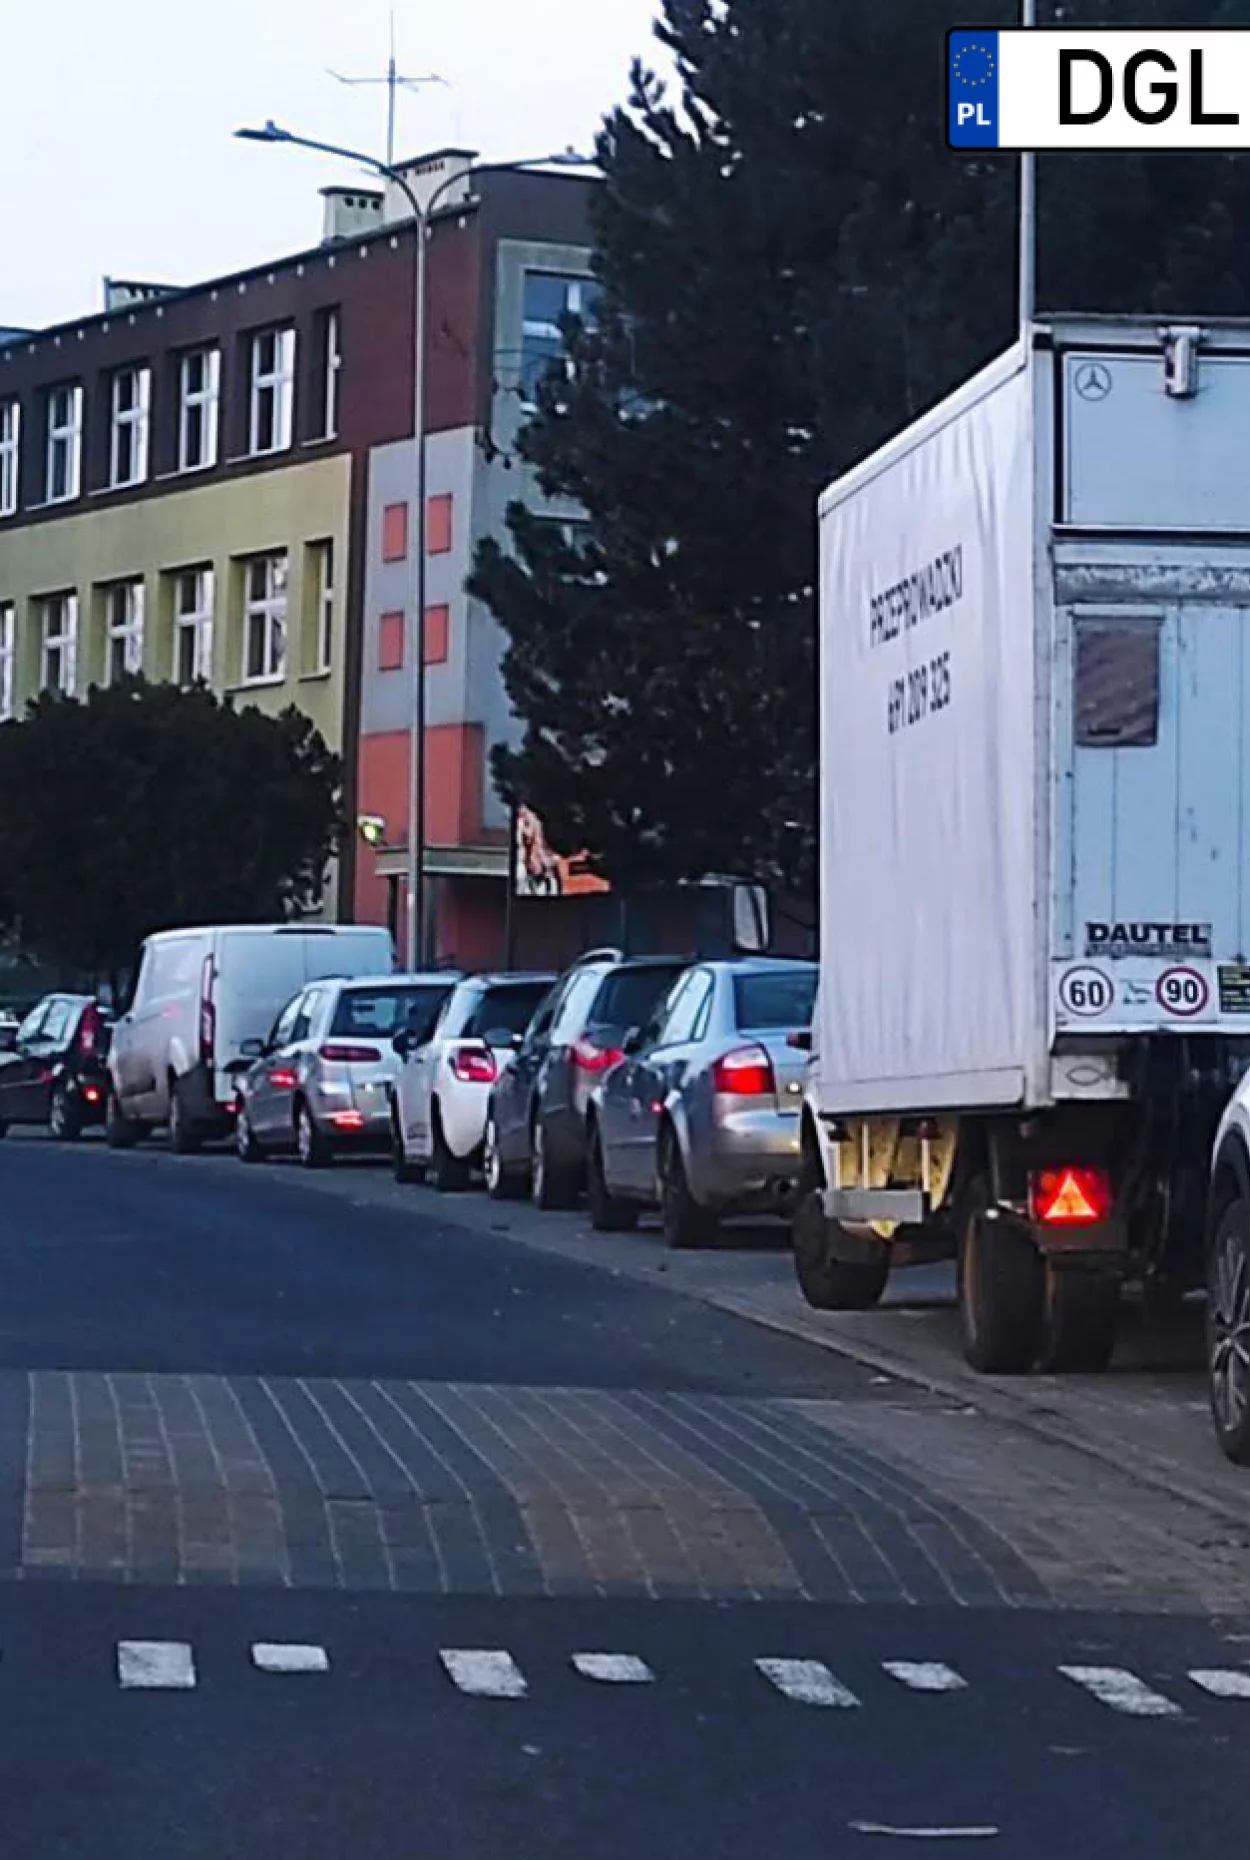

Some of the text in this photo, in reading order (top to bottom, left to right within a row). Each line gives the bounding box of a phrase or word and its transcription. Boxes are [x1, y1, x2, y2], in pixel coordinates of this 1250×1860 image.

[1087, 923, 1208, 944] DAUTEL
[1069, 979, 1104, 1007] 60
[1166, 979, 1199, 1003] 90
